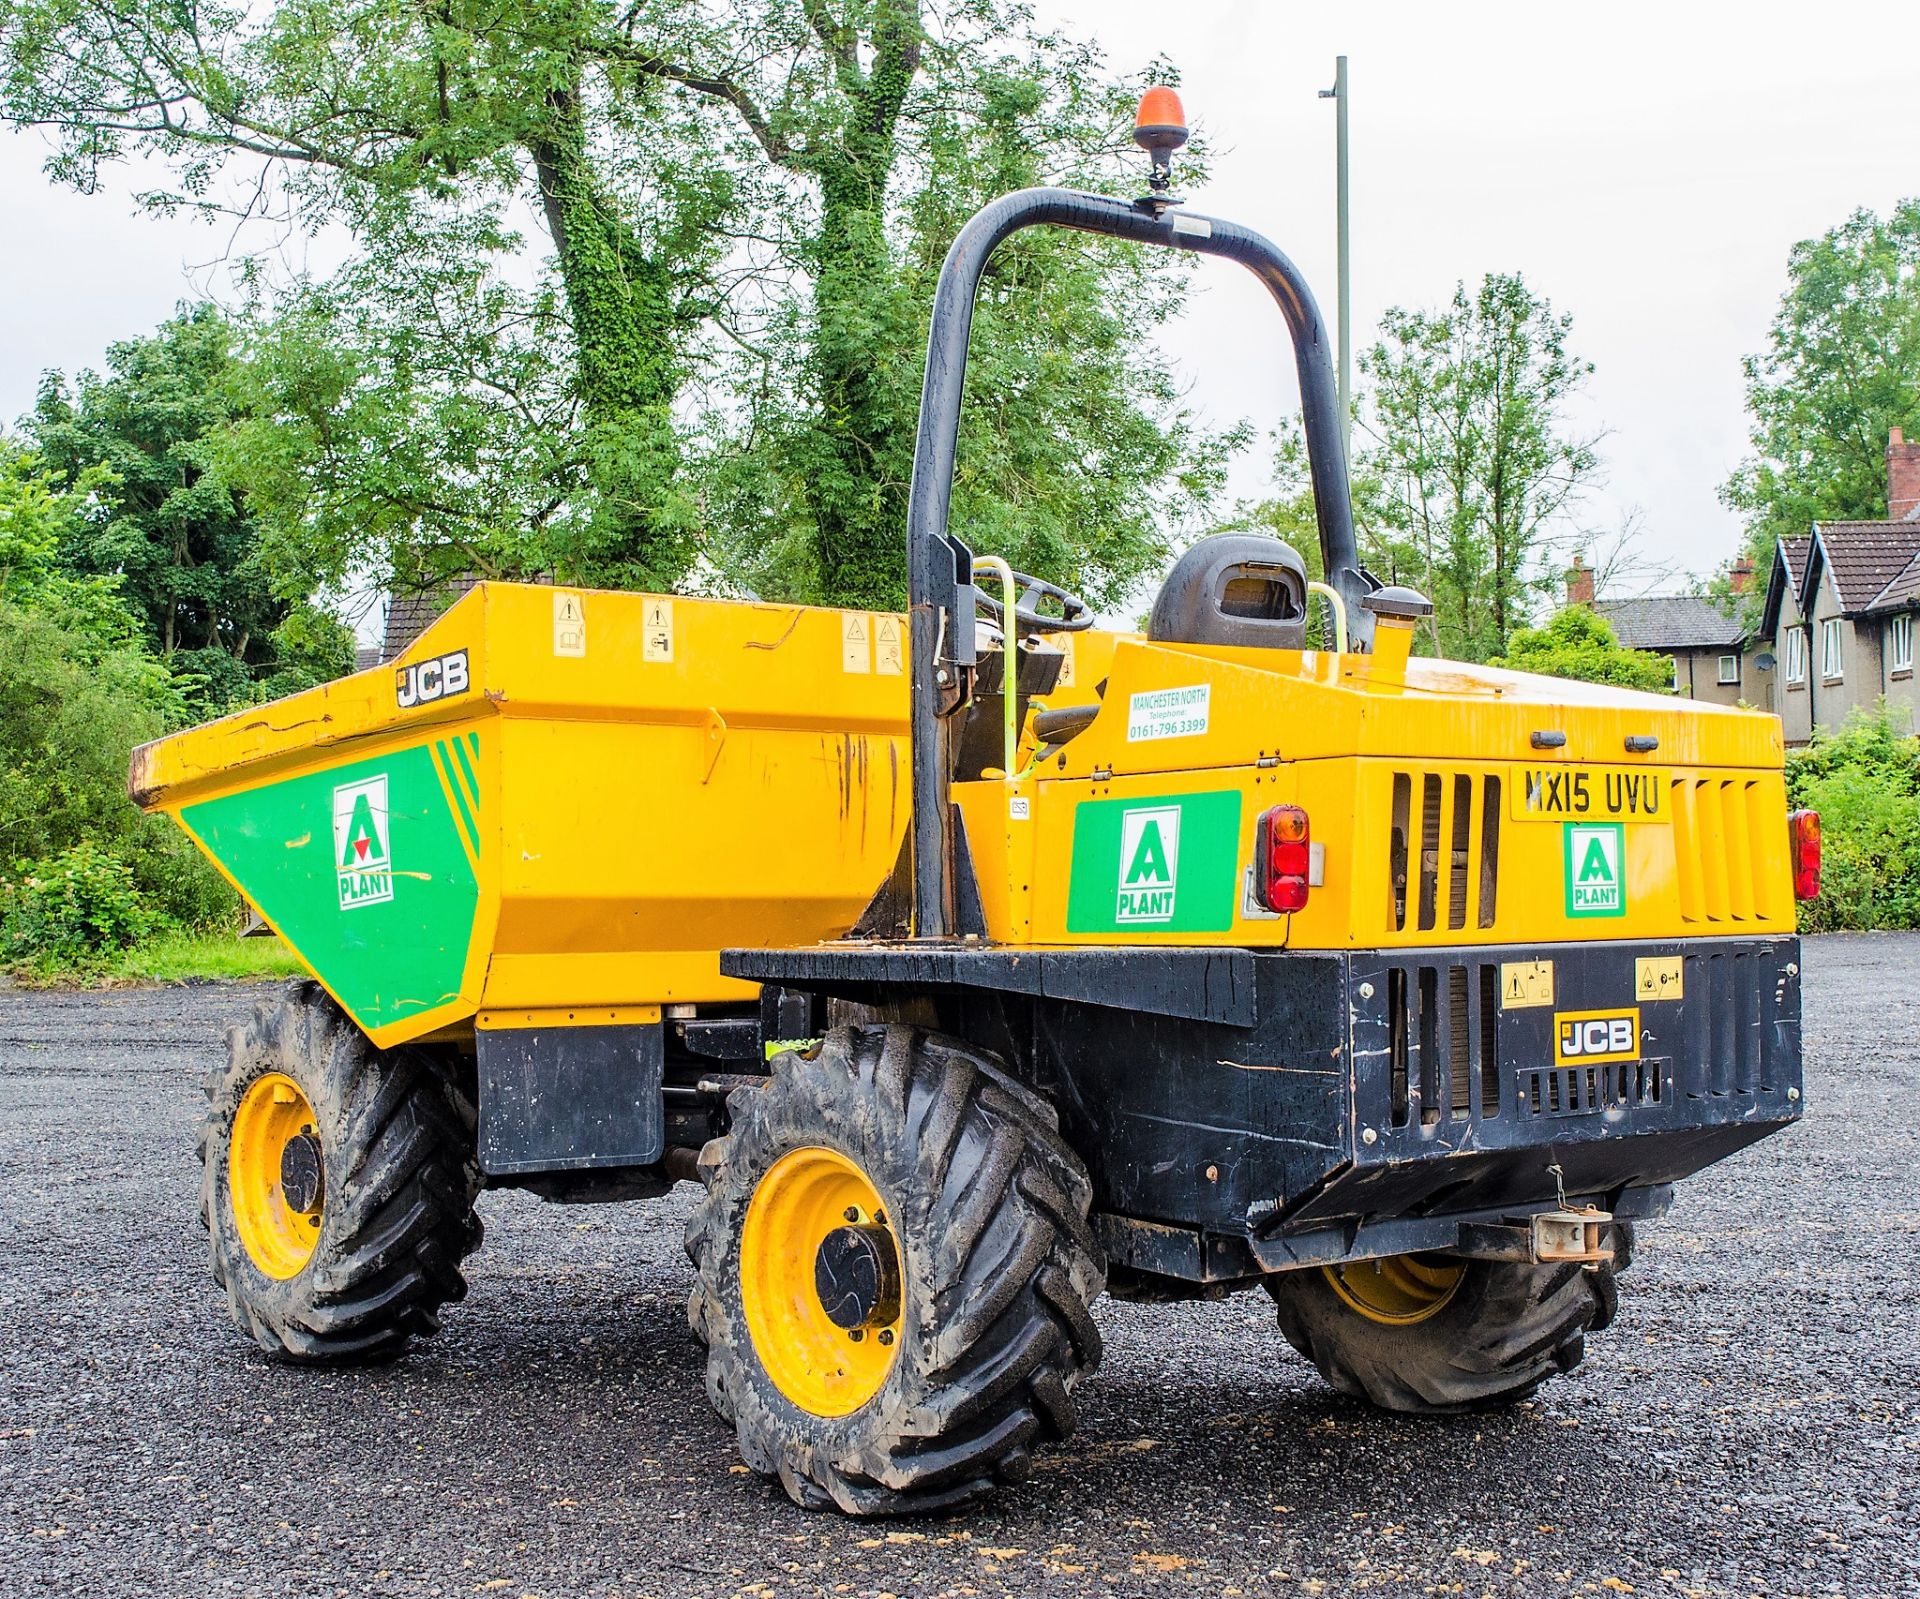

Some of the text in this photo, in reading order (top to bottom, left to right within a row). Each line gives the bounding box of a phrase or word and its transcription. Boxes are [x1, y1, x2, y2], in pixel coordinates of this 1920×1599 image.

[398, 653, 468, 706] JCB
[1133, 688, 1207, 710] MANCHESTER NORTH
[1130, 719, 1206, 738] 0161-796 3399
[1526, 770, 1659, 814] MX15 UVU
[343, 793, 385, 867] A
[1125, 819, 1171, 884] A
[1578, 837, 1614, 882] A
[340, 868, 390, 902] PLANT
[1118, 891, 1173, 915] PLANT
[1575, 887, 1617, 905] PLANT
[1561, 1019, 1633, 1055] JCB
